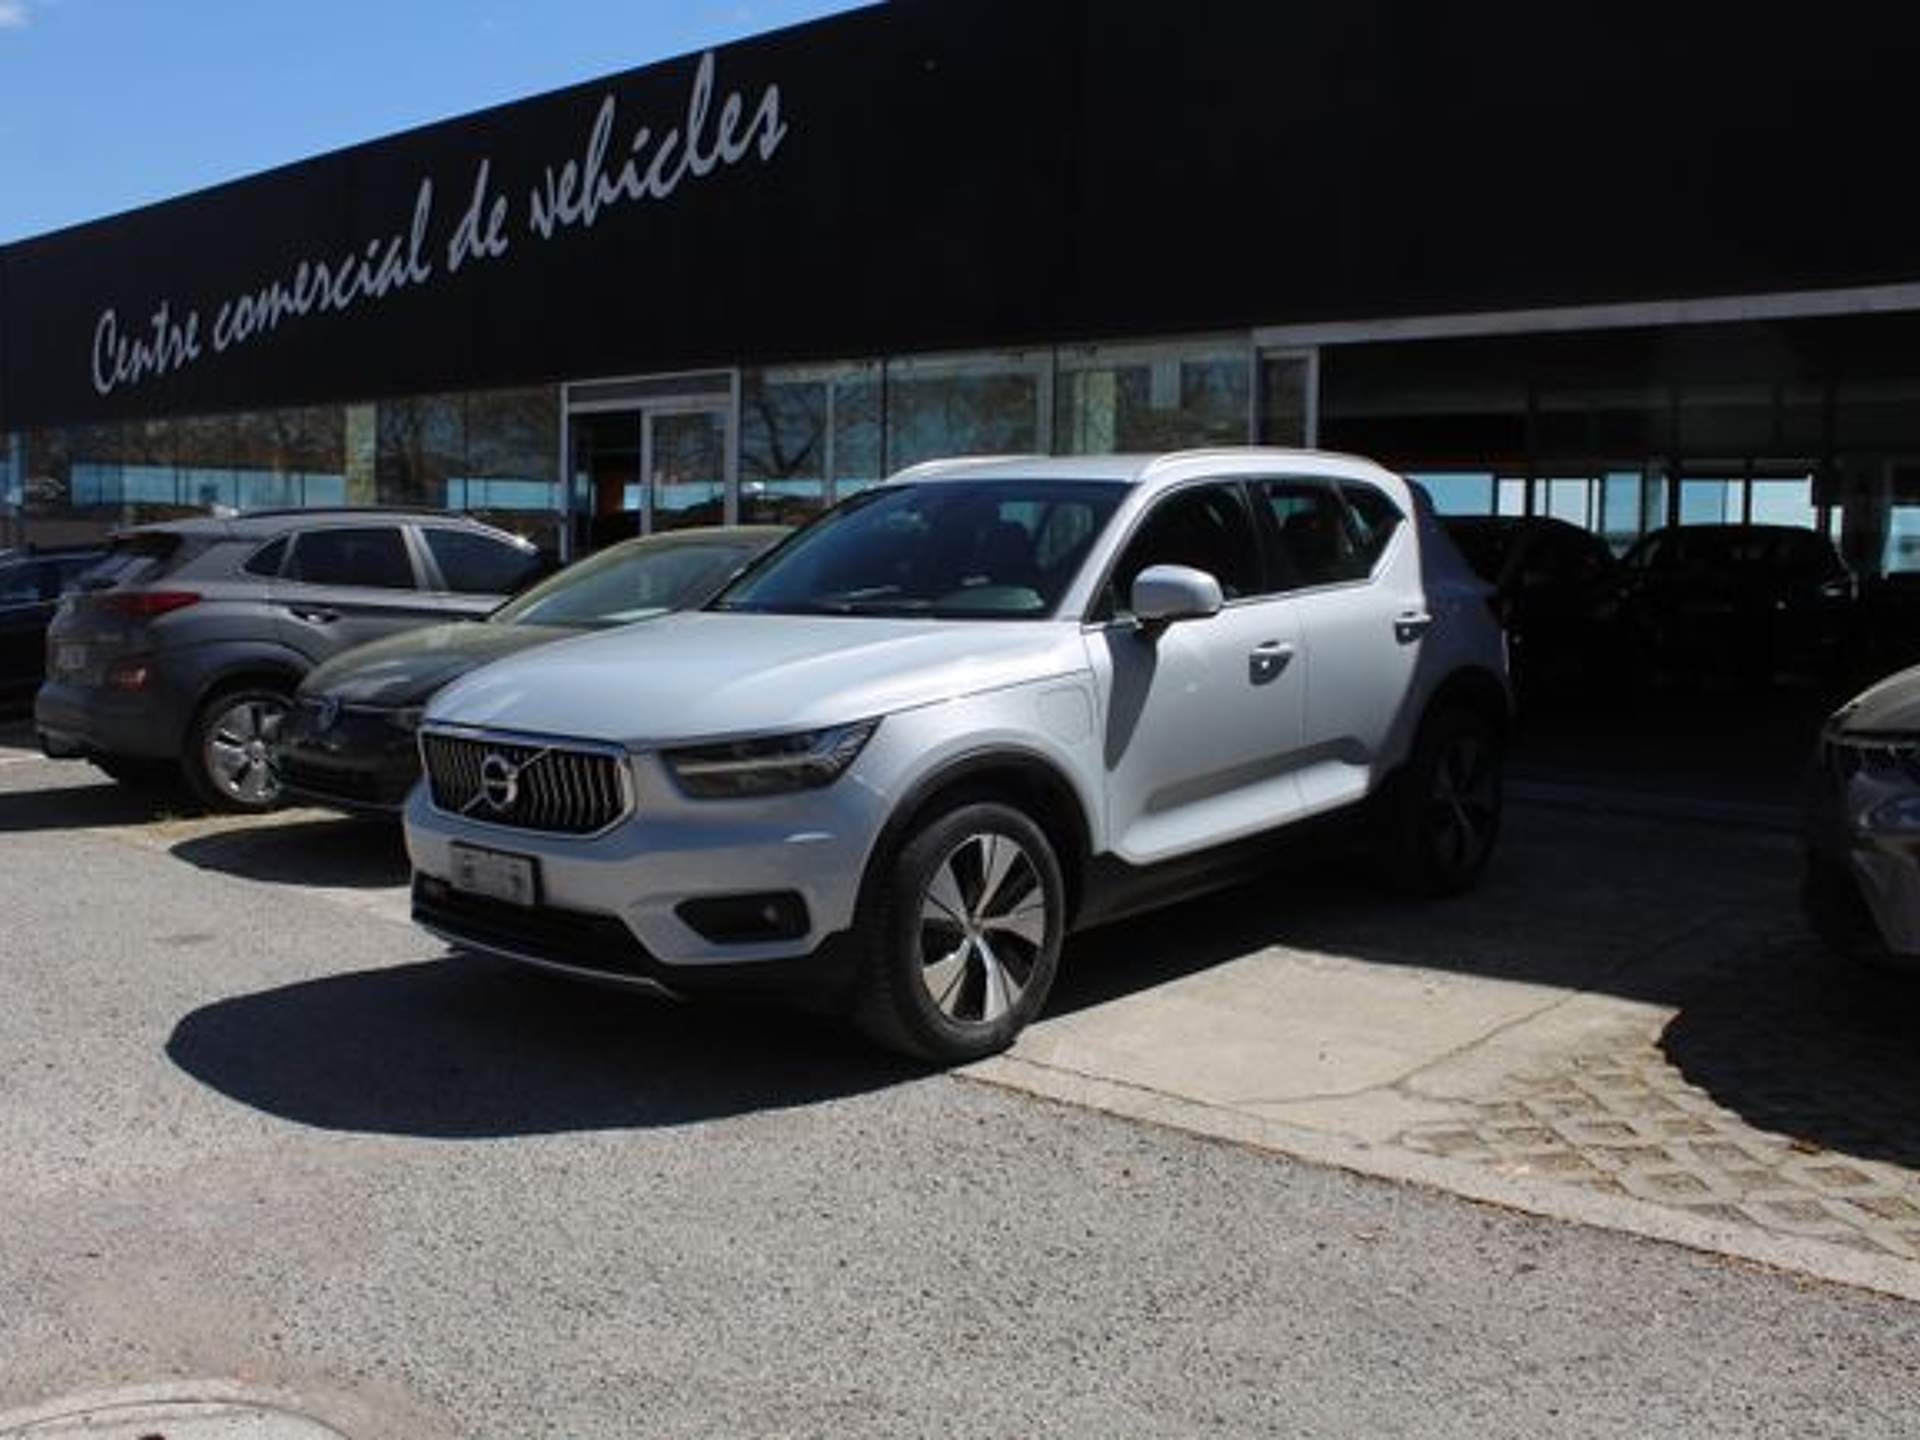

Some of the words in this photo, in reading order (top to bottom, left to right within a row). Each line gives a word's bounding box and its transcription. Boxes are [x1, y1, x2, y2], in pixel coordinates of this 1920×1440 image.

[92, 302, 201, 394] Centre
[213, 178, 433, 352] comercial
[447, 158, 509, 272] de
[529, 52, 788, 239] vehicles
